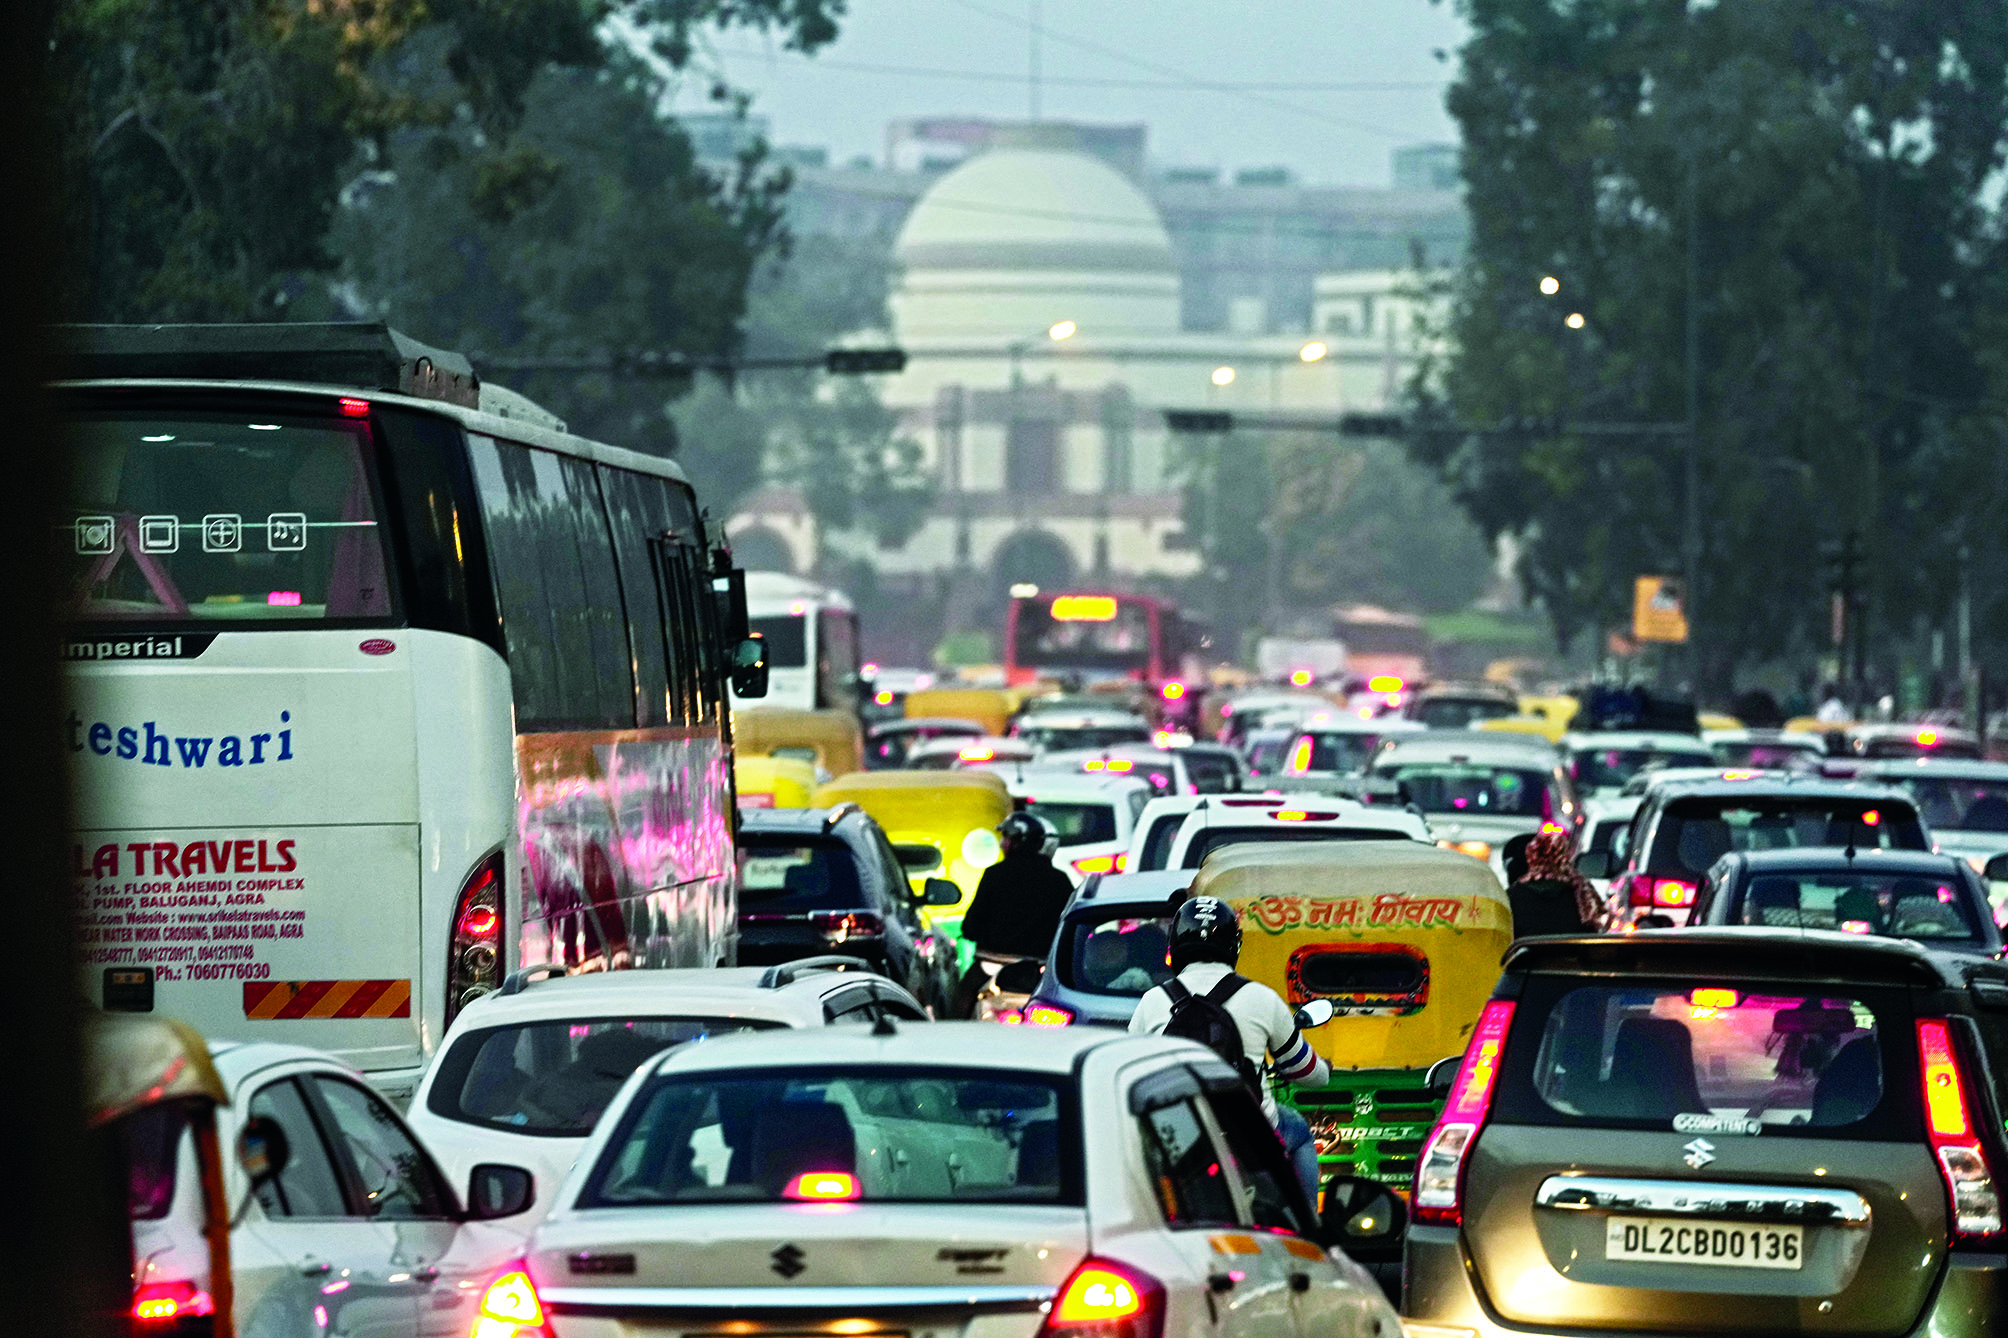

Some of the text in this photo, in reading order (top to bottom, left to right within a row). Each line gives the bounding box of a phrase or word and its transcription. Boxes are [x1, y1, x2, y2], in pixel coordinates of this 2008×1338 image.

[66, 710, 293, 768] teshwari
[71, 840, 297, 879] LA TRAVELS
[124, 882, 172, 894] FLOOR
[176, 880, 232, 892] AHEMDI
[236, 878, 305, 891] COMPLEX
[93, 896, 136, 910] PUMP,
[140, 894, 221, 908] BALUGANJ,
[225, 893, 265, 905] AGRA
[186, 963, 271, 980] 7060776030
[1623, 1225, 1799, 1261] DL2CBD0136
